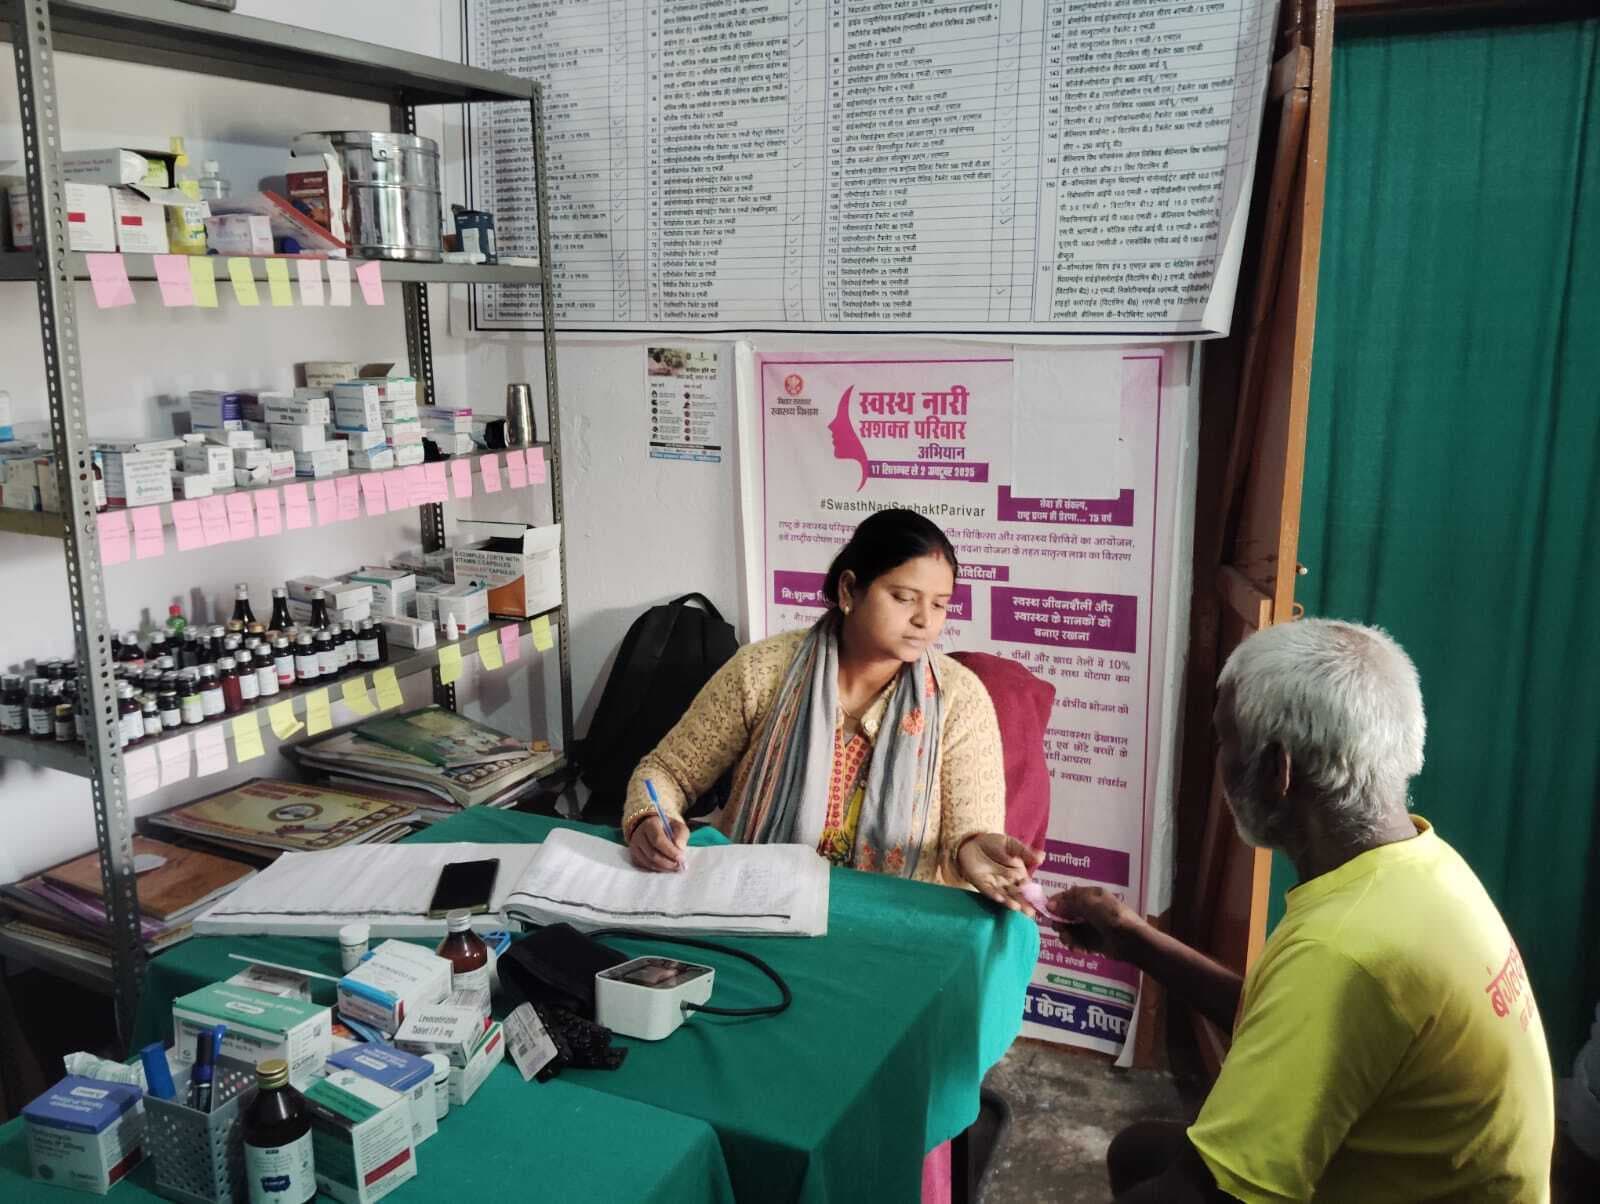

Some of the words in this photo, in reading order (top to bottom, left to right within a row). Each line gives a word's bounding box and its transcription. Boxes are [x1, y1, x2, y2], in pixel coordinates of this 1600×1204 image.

[858, 391, 914, 416] स्वस्थ
[921, 385, 970, 416] नारी
[858, 420, 910, 440] सशक्त
[914, 416, 967, 440] परिवार
[918, 443, 966, 460] अभियान
[998, 530, 1014, 540] और
[1016, 532, 1047, 543] स्वास्थ्य
[1080, 536, 1092, 544] का
[1012, 546, 1020, 555] के
[1088, 552, 1100, 560] का
[1102, 550, 1132, 562] वितरण
[1012, 596, 1040, 610] स्वस्थ
[1042, 597, 1092, 612] जीवनशैली
[1094, 598, 1114, 613] और
[1014, 611, 1050, 624] स्वास्थ्य
[1051, 611, 1062, 624] के
[1063, 613, 1096, 628] मानकों
[1097, 616, 1112, 628] को
[1034, 627, 1060, 640] बनाए
[1062, 630, 1090, 641] रखना
[1034, 652, 1049, 662] और
[1110, 660, 1131, 671] 10%
[1048, 667, 1056, 676] के
[1060, 668, 1080, 678] साथ
[1084, 670, 1110, 681] मोटापा
[1116, 674, 1130, 683] कम
[1089, 700, 1115, 712] भोजन
[1118, 704, 1128, 714] को
[1074, 742, 1089, 753] छोटे
[1120, 747, 1128, 758] के
[1062, 755, 1092, 766] आचरण
[1048, 852, 1091, 868] भागीदारी
[1035, 993, 1077, 1023] केन्द्र
